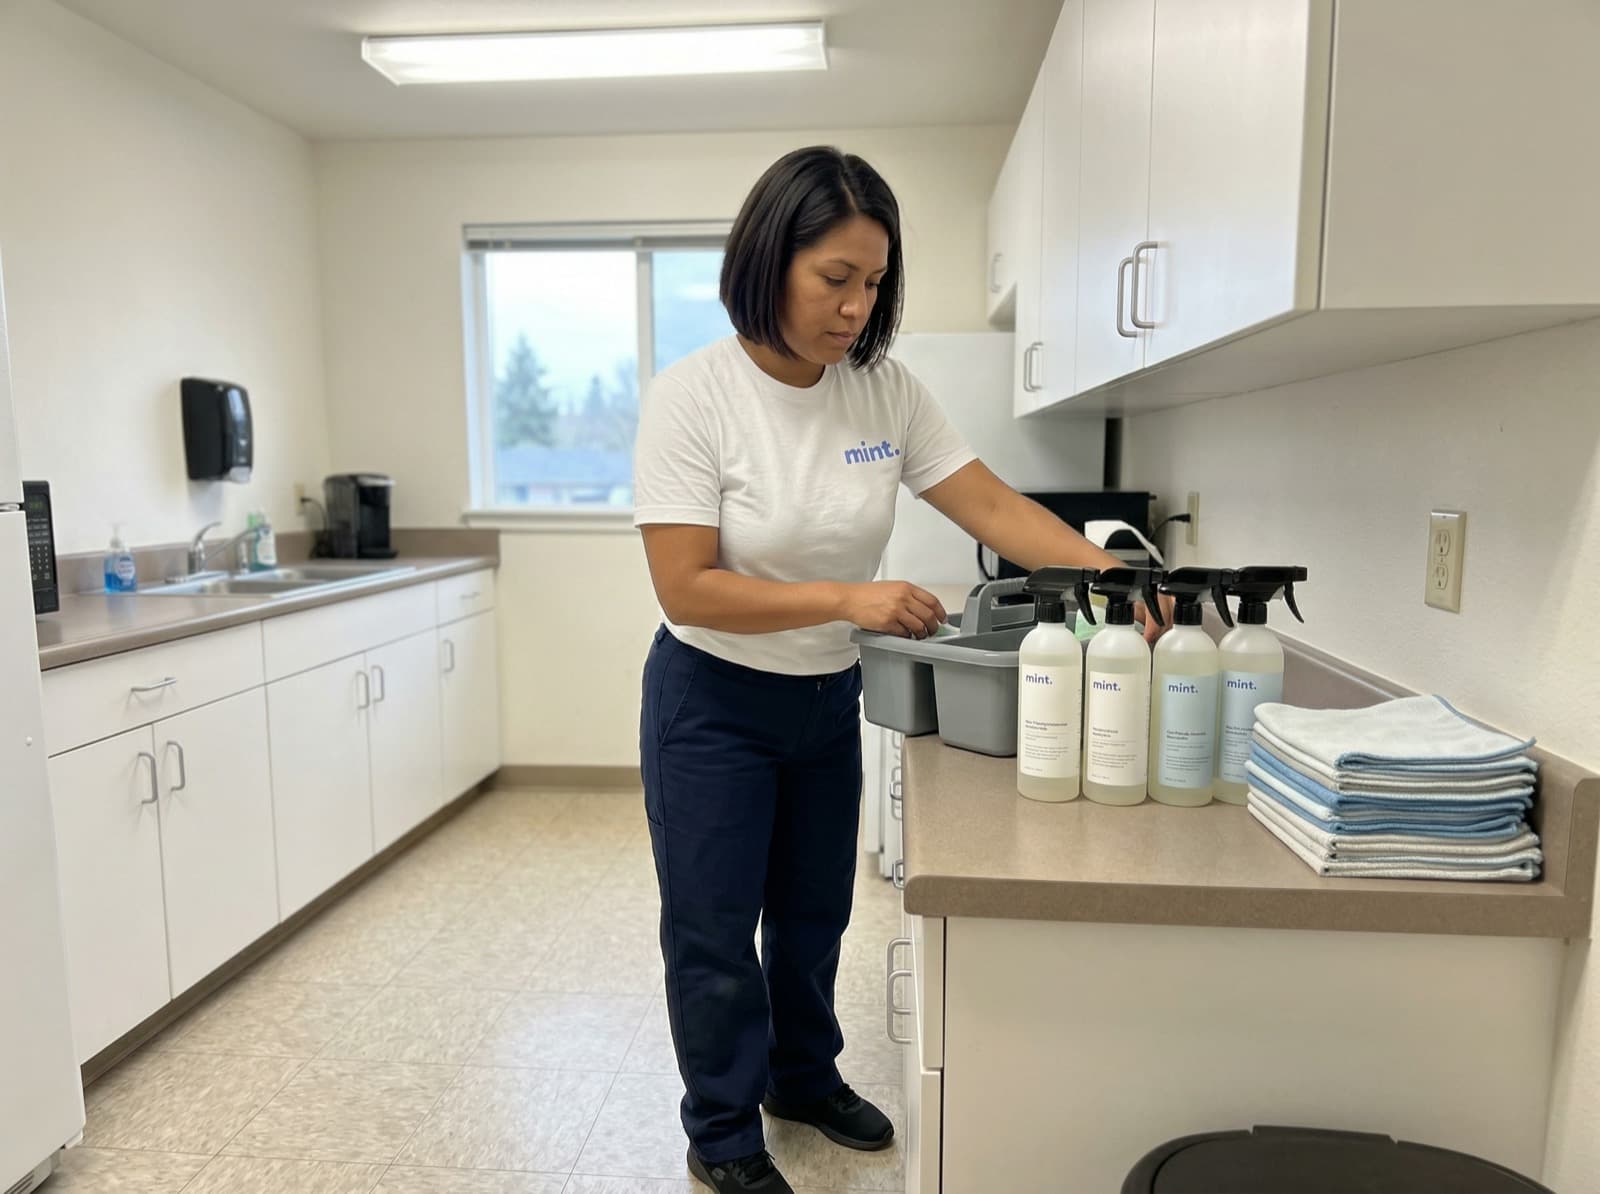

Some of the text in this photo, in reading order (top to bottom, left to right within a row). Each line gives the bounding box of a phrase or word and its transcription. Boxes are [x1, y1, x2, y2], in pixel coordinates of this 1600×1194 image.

[845, 440, 900, 464] mint.
[1026, 673, 1053, 685] mint.
[1227, 679, 1257, 690] mint.
[1093, 680, 1121, 692] mint.
[1168, 683, 1199, 694] mint.
